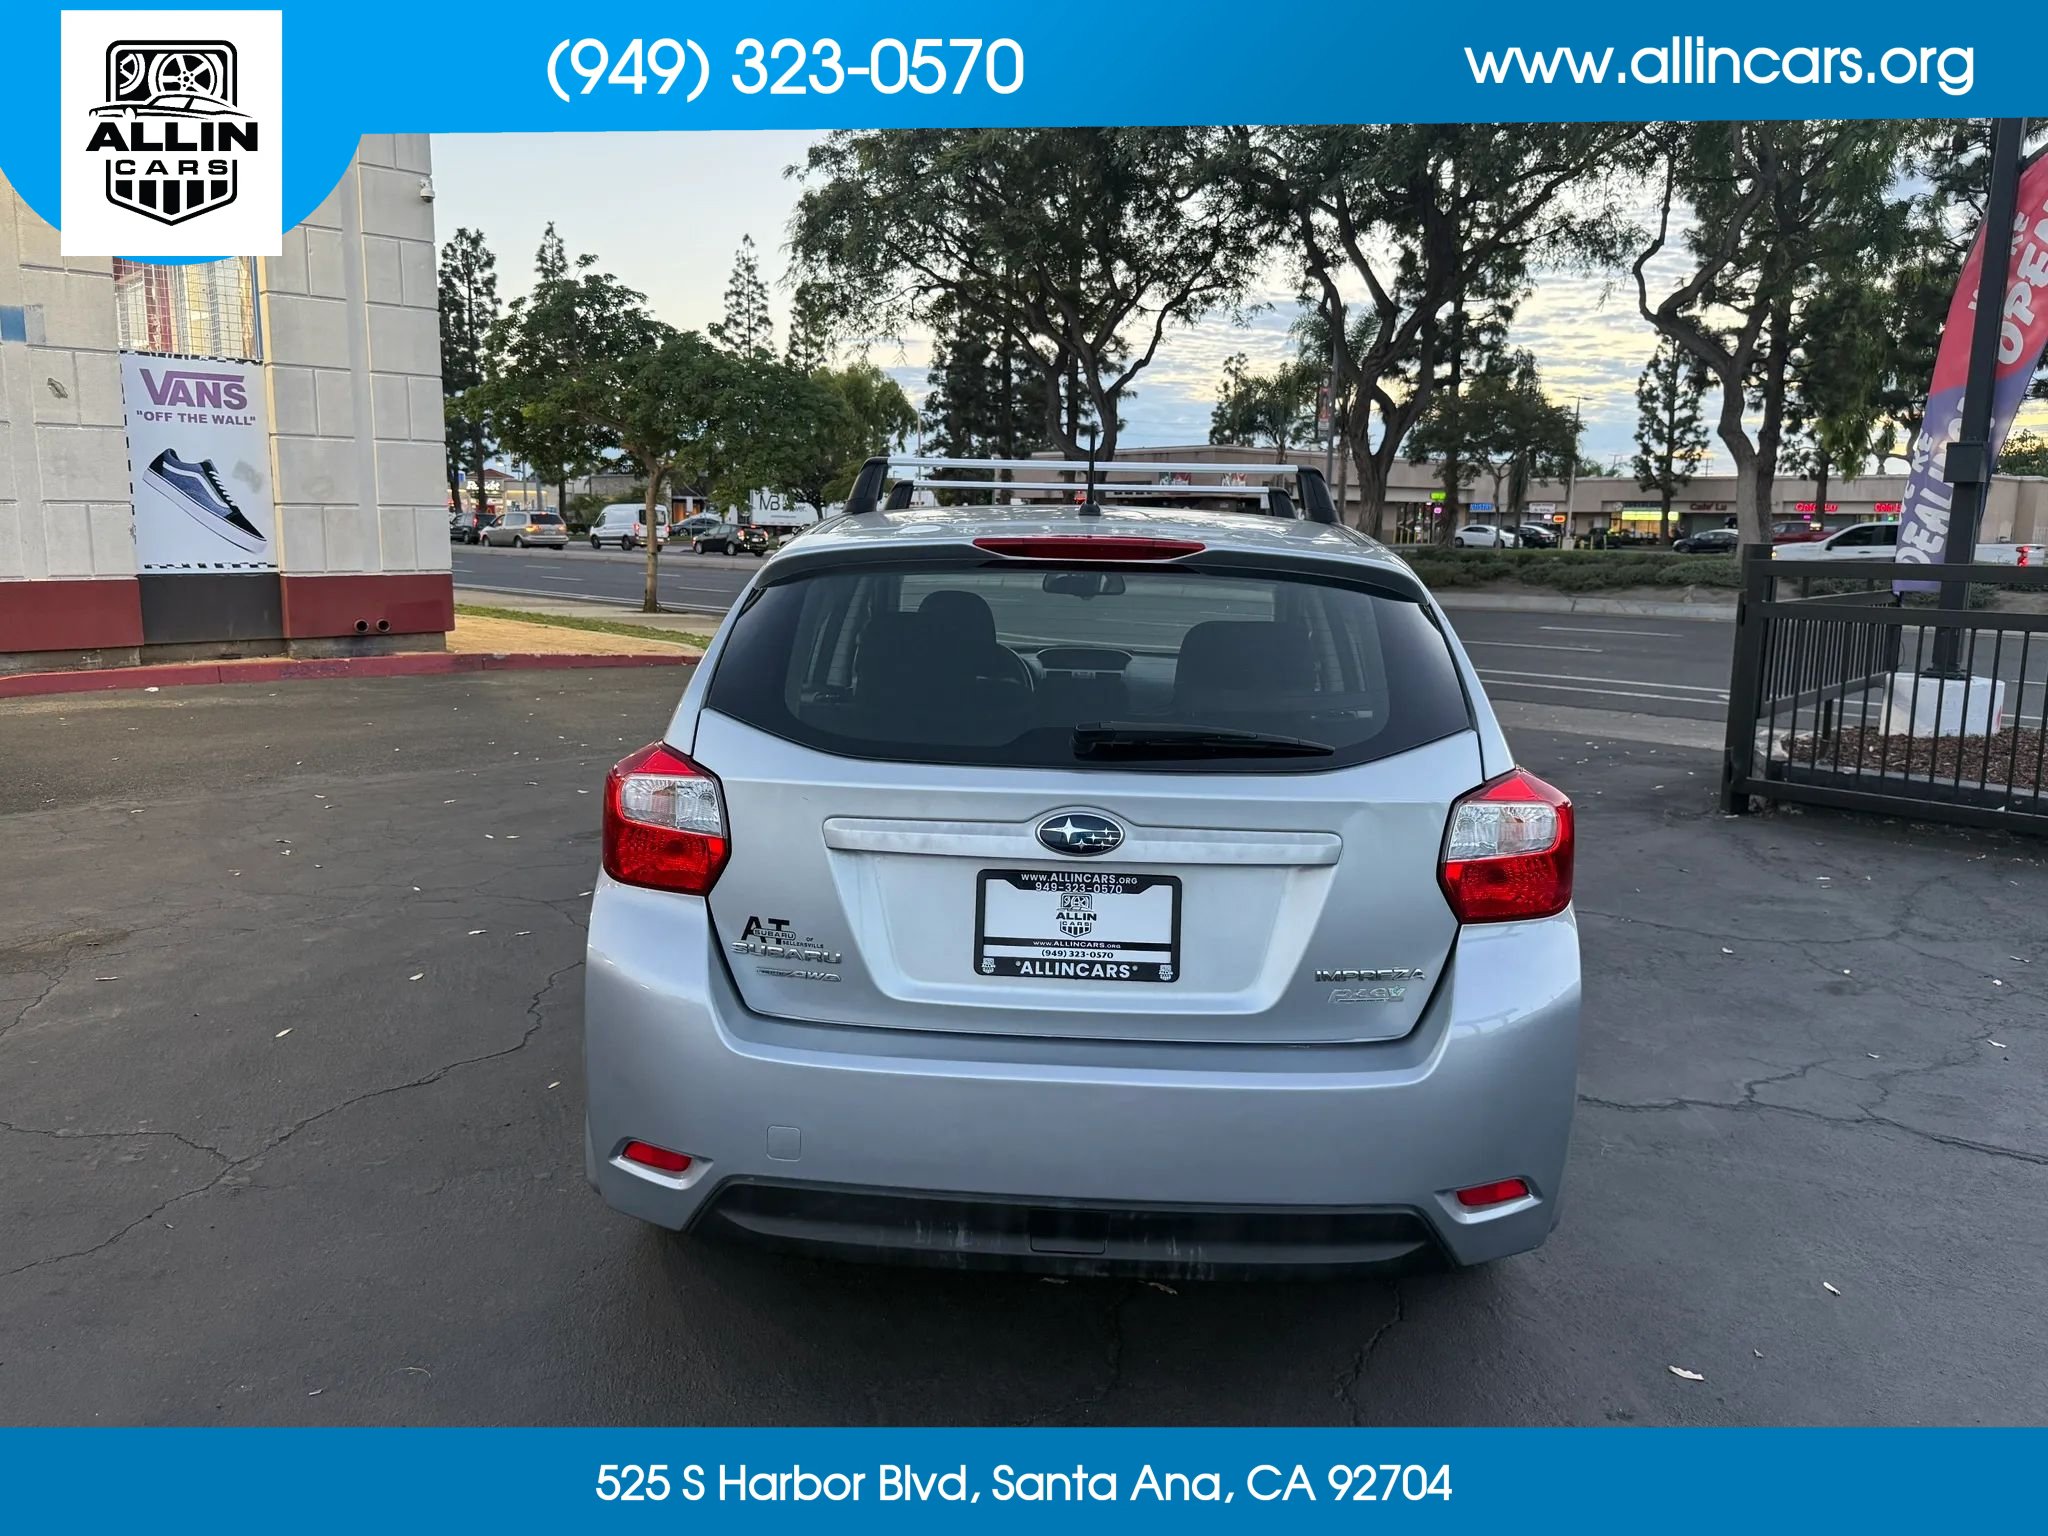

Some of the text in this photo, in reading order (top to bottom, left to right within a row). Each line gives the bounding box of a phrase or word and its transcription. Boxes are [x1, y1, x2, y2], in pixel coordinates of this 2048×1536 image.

[139, 368, 247, 411] VANS
[178, 413, 208, 424] THE
[1035, 882, 1123, 894] 949-323-0570
[1056, 912, 1097, 921] ALLIN
[754, 928, 794, 939] SUBARU
[731, 942, 842, 964] SUBARU
[1041, 949, 1114, 959] (949) 323-0570
[1020, 961, 1131, 978] ALLINCARS
[1315, 968, 1426, 982] IMPREZA
